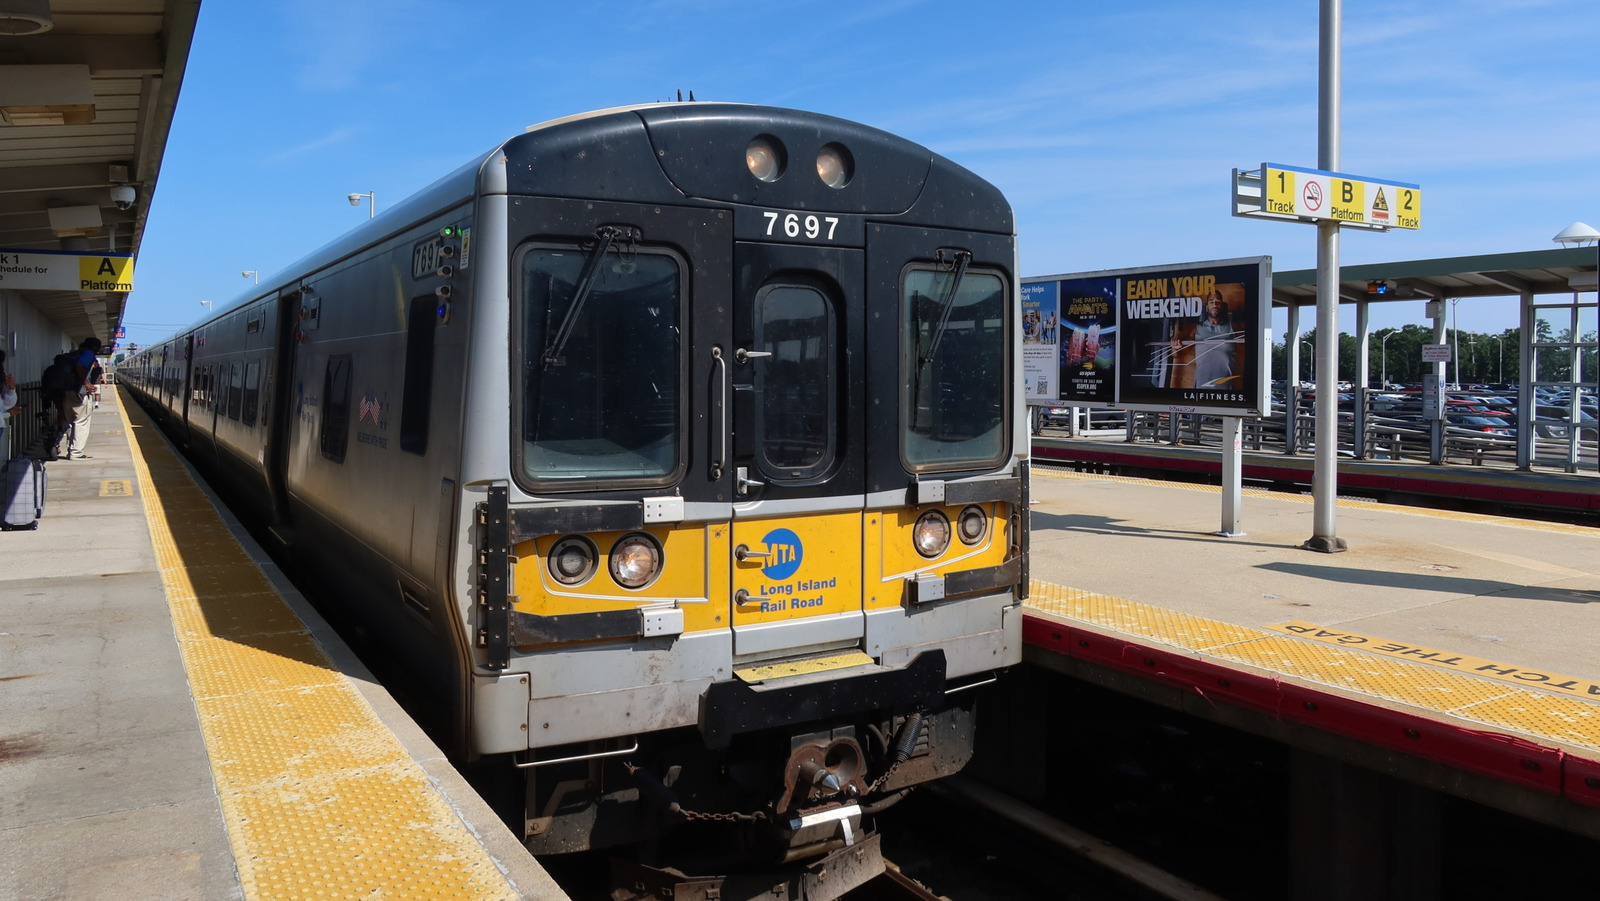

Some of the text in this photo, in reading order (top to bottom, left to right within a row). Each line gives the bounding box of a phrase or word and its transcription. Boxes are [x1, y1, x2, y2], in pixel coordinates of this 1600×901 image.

[1278, 171, 1285, 194] 1
[1342, 182, 1354, 203] B
[1404, 190, 1413, 210] 2
[1268, 199, 1294, 214] Track
[1331, 207, 1364, 222] Platform
[763, 212, 839, 240] 7697
[1397, 215, 1419, 228] Track
[13, 254, 19, 264] 1
[97, 258, 116, 276] A
[415, 241, 440, 275] 7697
[0, 265, 32, 274] hedule
[81, 280, 132, 290] Platform
[1032, 286, 1044, 294] Helps
[1127, 274, 1216, 300] EARN YOUR
[1068, 302, 1108, 315] AWAITS
[1126, 296, 1202, 320] WEEKEND
[1200, 393, 1244, 402] FITNESS
[761, 542, 796, 570] MTA
[760, 577, 836, 596] Long Island
[760, 596, 824, 612] Rail Road
[1285, 625, 1600, 695] TCH THE GAP
